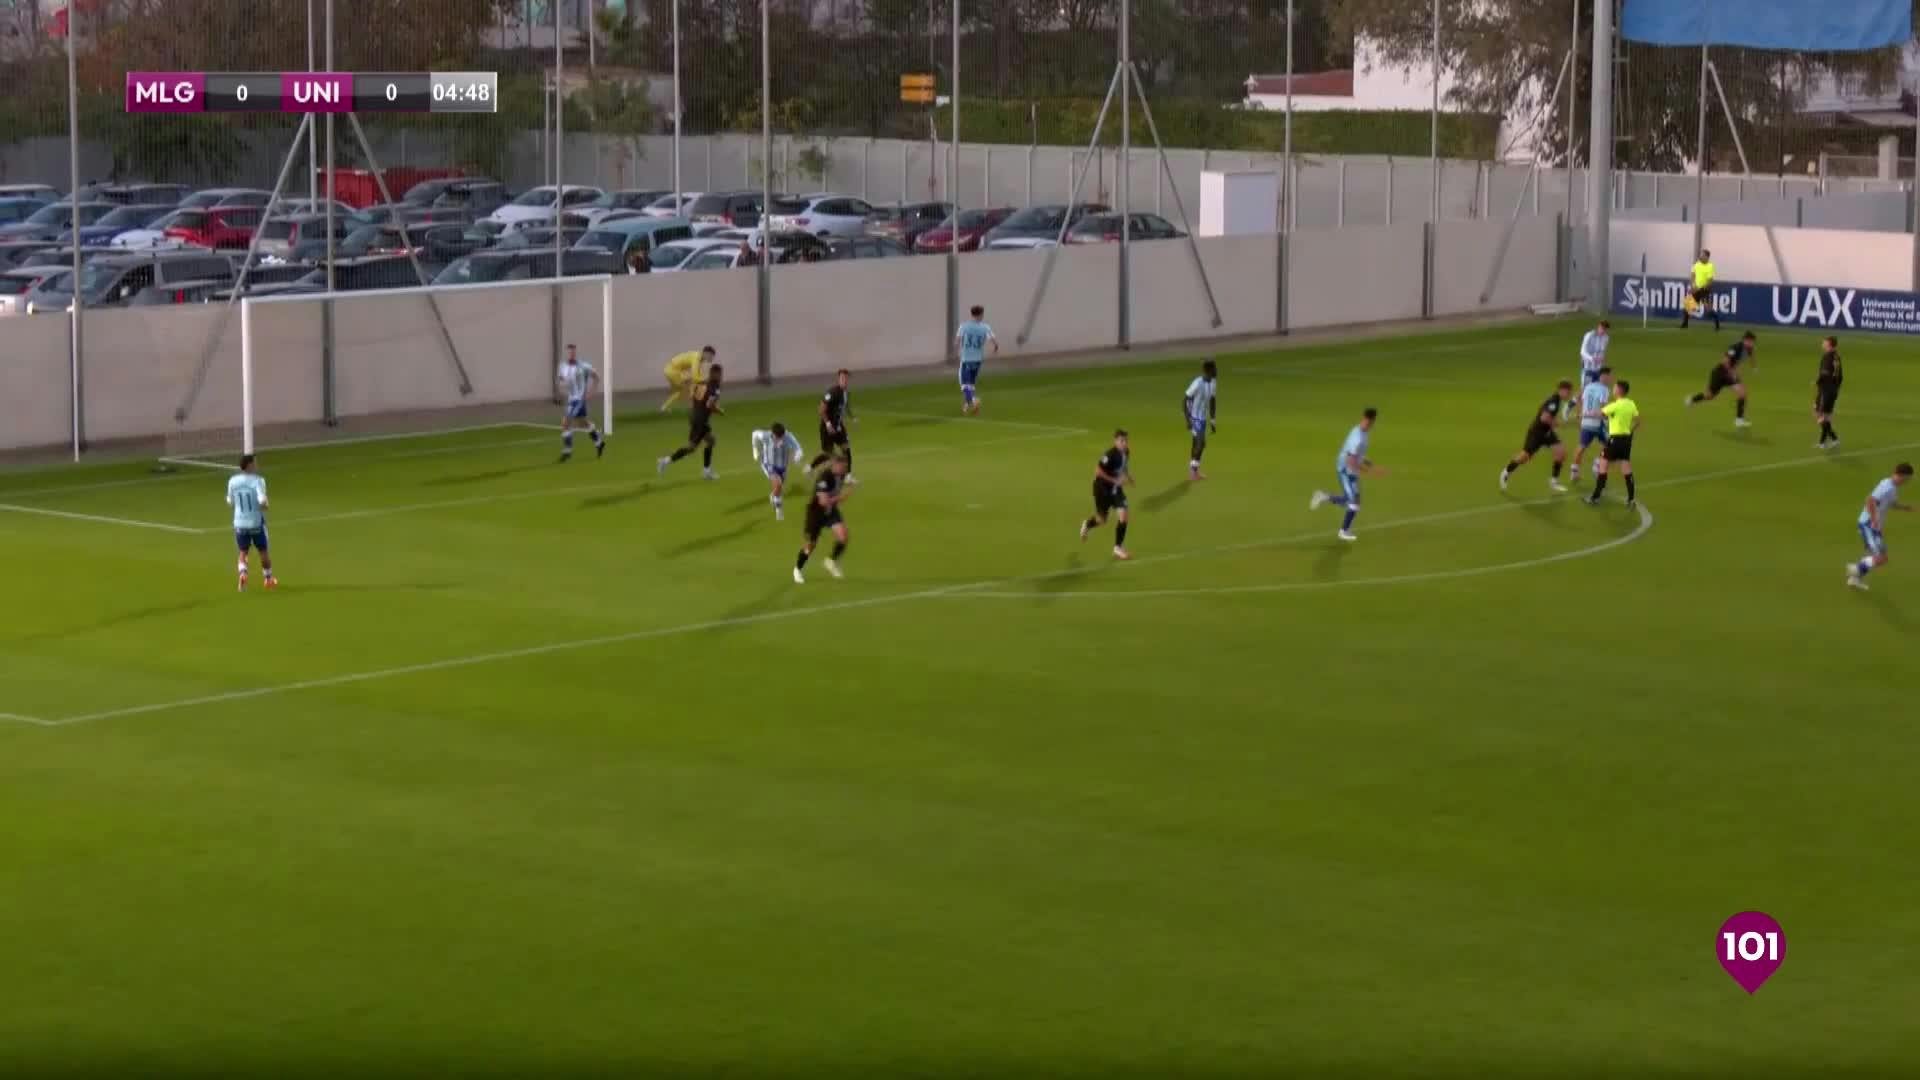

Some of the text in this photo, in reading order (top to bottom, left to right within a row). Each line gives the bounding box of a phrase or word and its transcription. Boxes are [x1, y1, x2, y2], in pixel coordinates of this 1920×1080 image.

[1772, 285, 1857, 328] UAX
[1862, 297, 1915, 309] Universidad
[1862, 307, 1896, 319] Alfonso
[1897, 310, 1904, 320] X
[1861, 318, 1883, 329] Mare
[238, 491, 253, 513] 11
